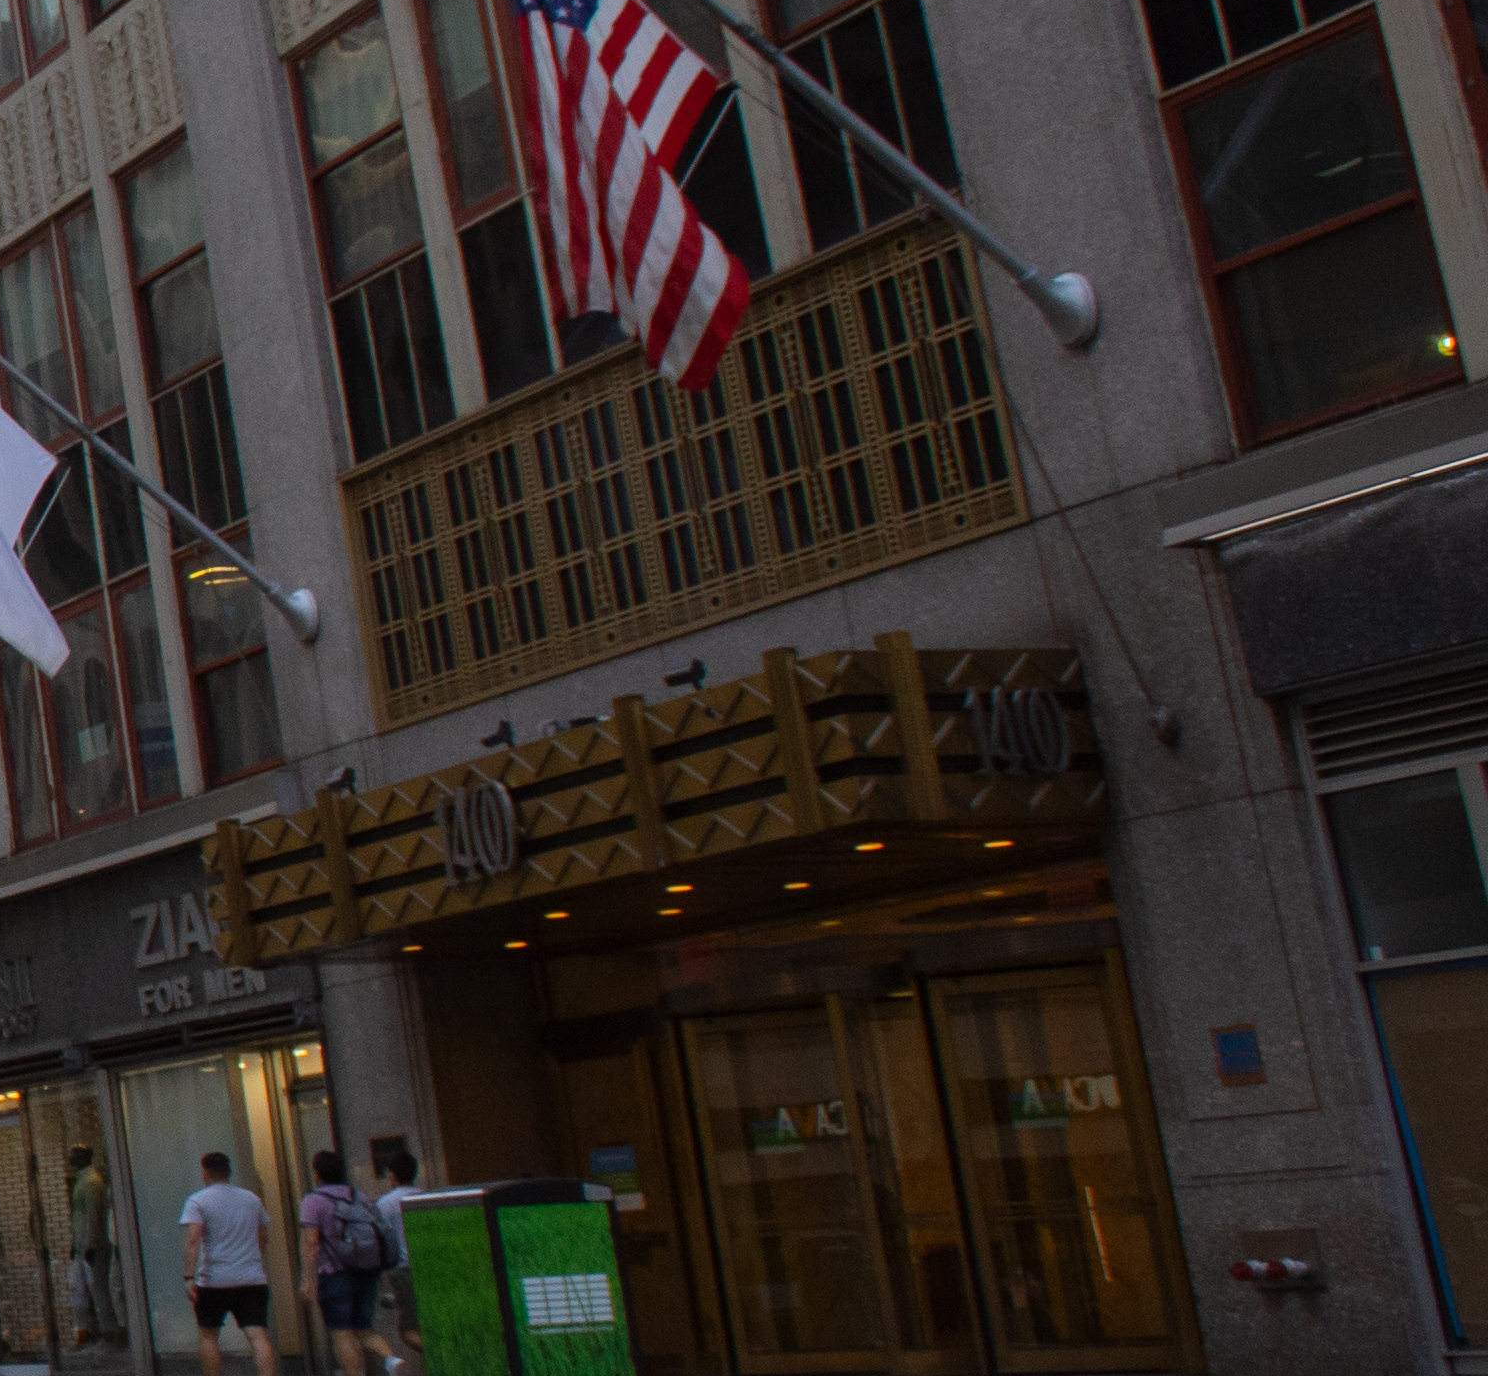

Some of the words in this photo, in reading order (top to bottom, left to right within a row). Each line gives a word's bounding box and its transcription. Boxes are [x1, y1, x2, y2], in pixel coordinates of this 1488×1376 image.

[130, 888, 229, 969] ZIA
[140, 975, 194, 1017] FOR
[201, 965, 267, 1004] MEN
